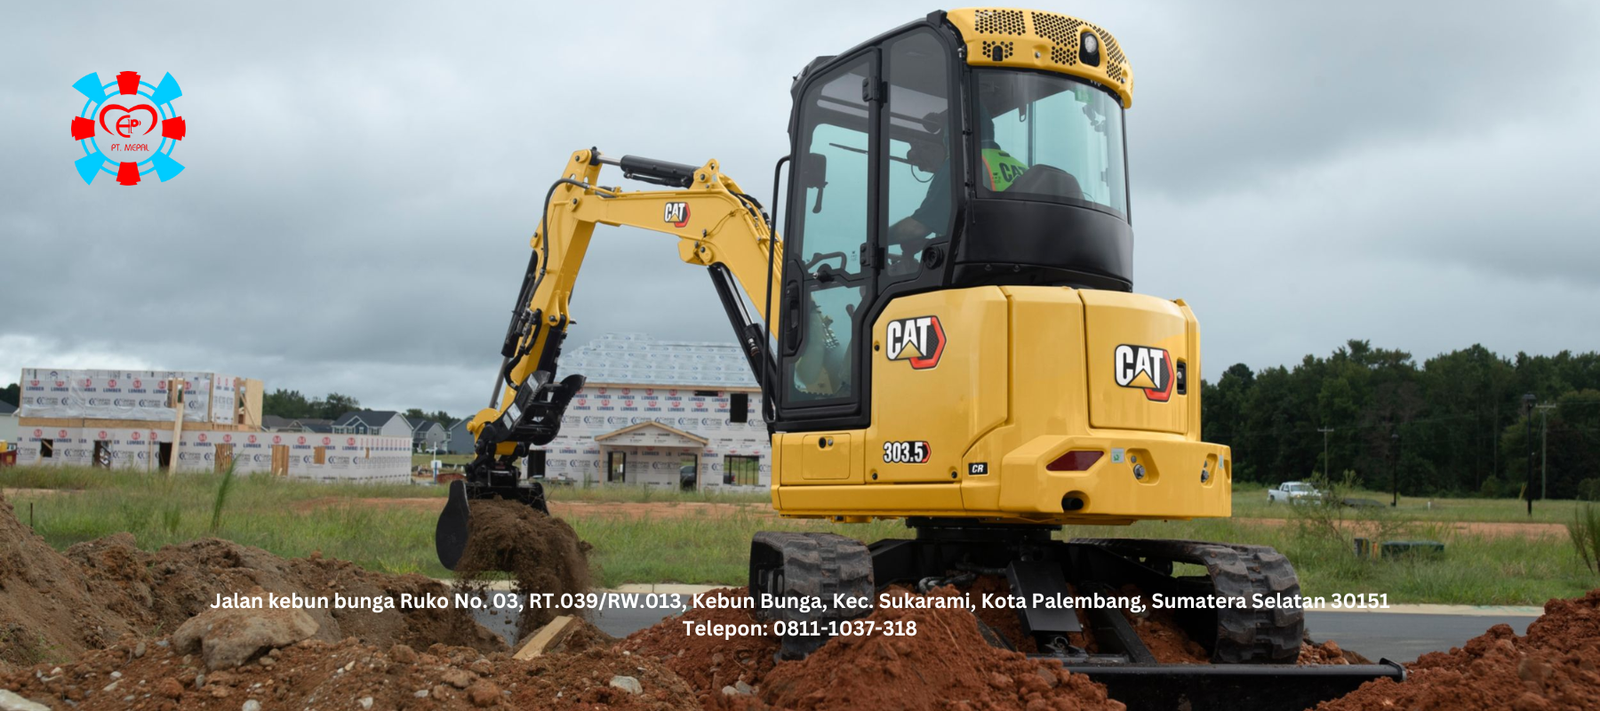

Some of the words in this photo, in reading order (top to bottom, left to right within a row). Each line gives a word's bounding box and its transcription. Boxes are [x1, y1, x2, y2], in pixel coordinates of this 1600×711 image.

[665, 202, 685, 222] CAT
[887, 316, 931, 360] CAT
[1115, 344, 1164, 388] CAT
[883, 442, 924, 463] 303.5
[971, 464, 984, 473] CR
